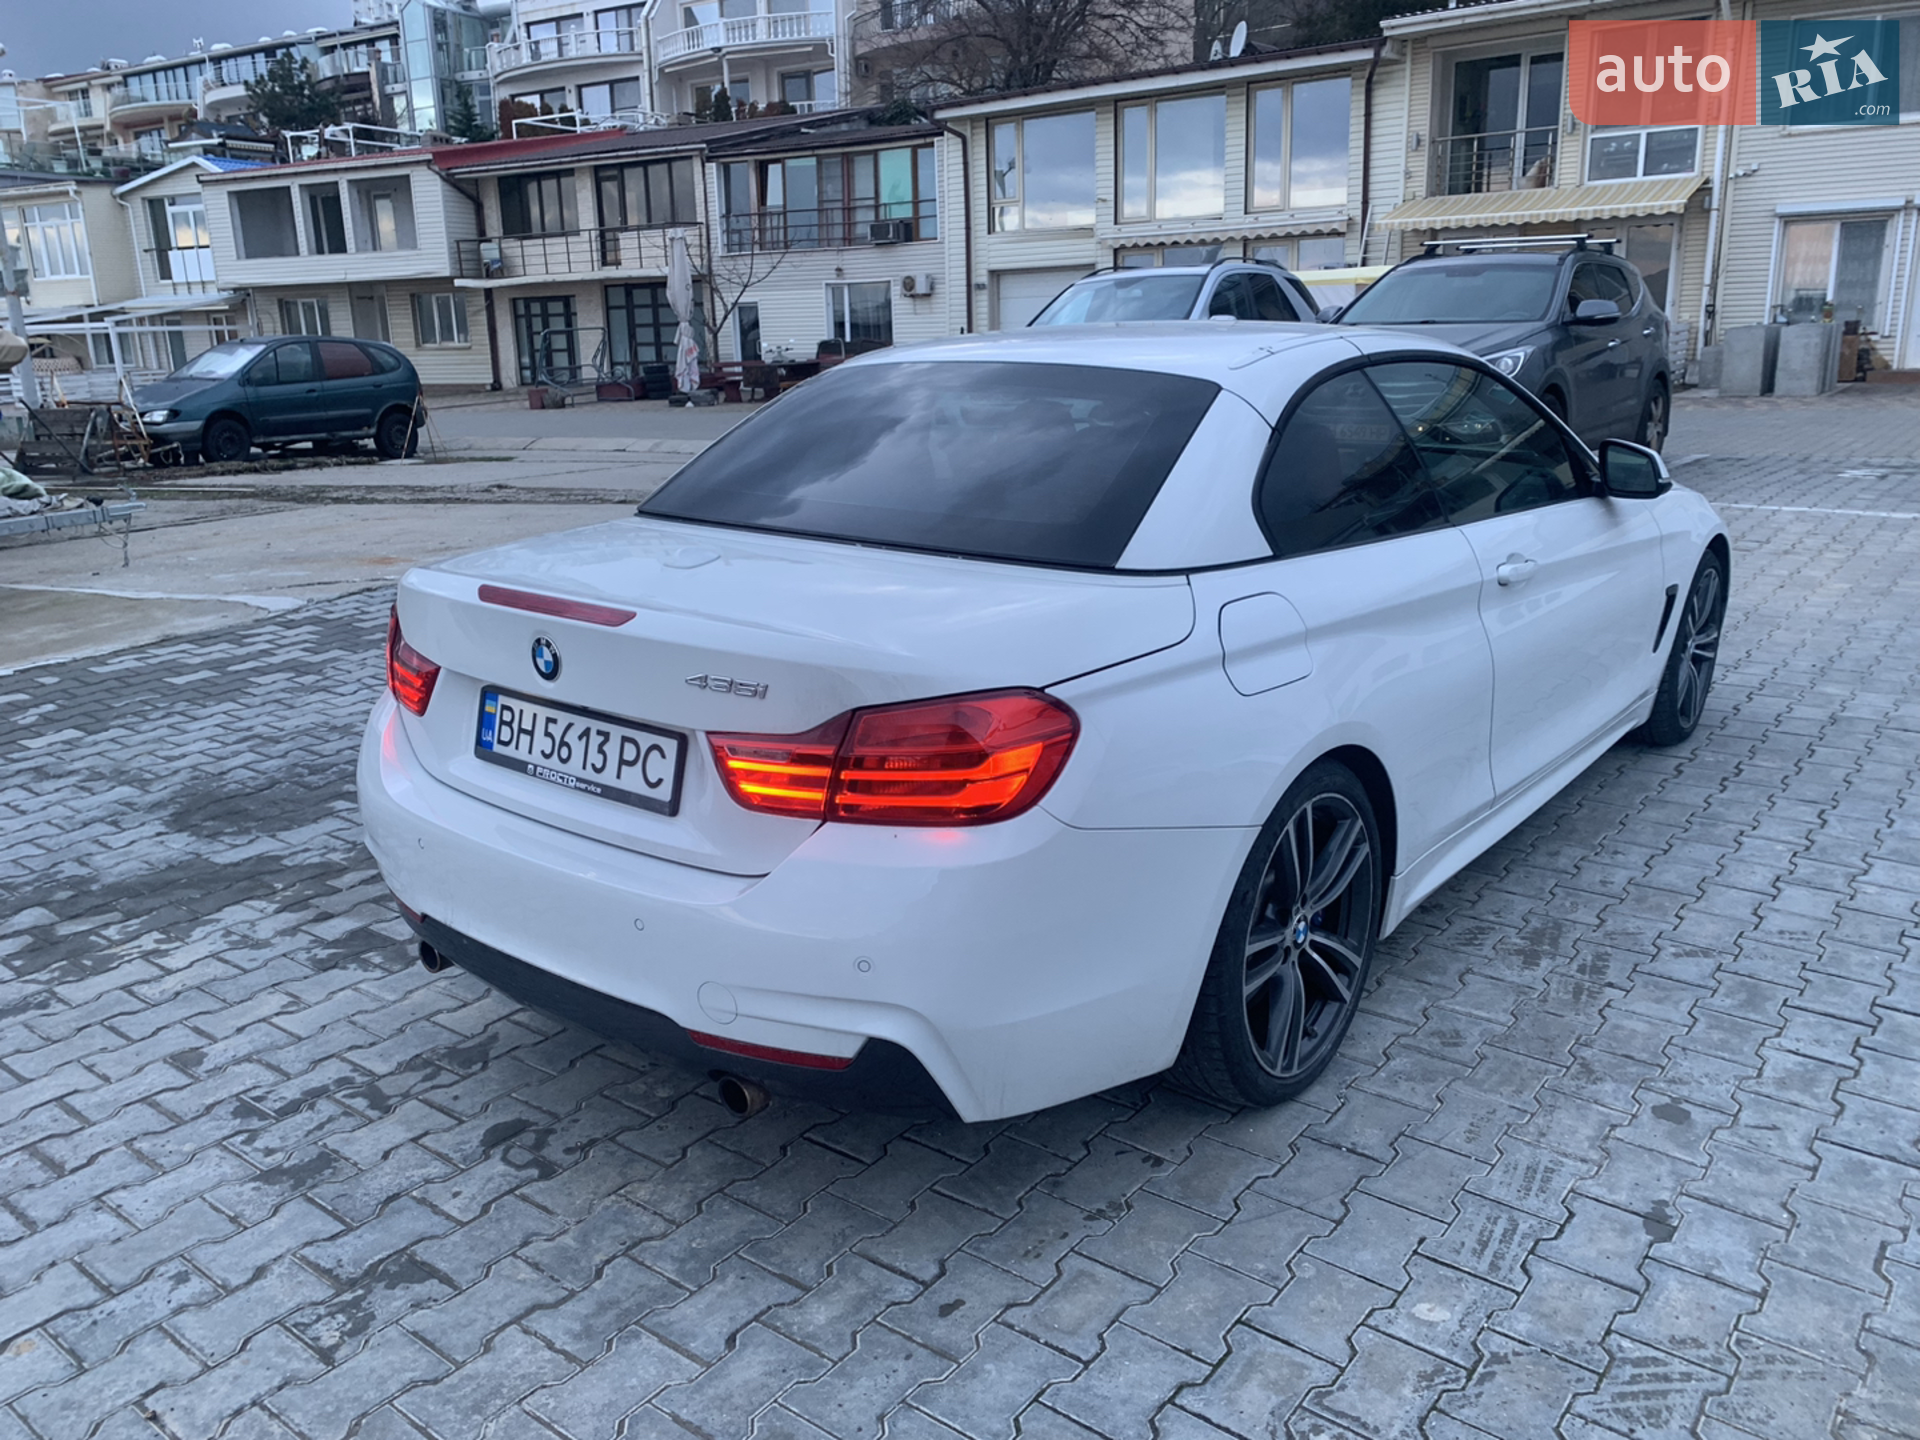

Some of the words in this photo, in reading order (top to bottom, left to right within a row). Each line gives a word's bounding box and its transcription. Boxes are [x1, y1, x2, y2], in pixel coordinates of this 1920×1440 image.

[684, 672, 769, 700] 435i
[482, 727, 494, 745] UA
[496, 704, 538, 755] BH
[540, 716, 611, 774] 5613
[615, 735, 667, 789] PC
